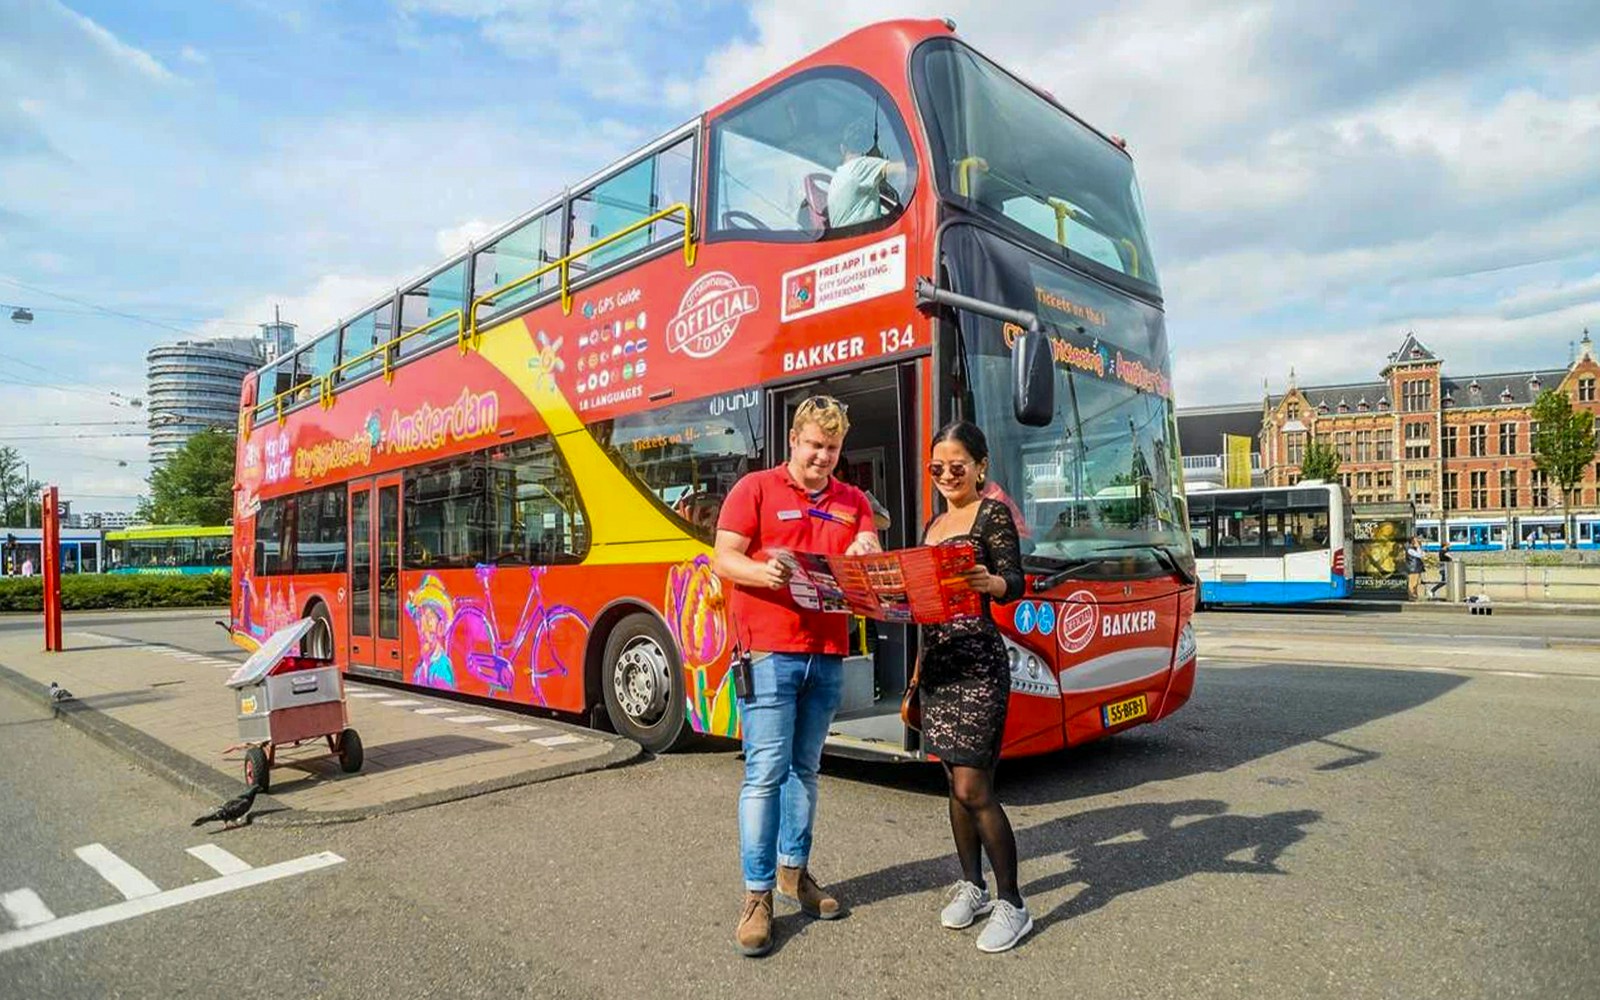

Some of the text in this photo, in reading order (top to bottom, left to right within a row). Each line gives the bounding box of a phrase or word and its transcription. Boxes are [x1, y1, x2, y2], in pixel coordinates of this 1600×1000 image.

[820, 257, 860, 278] FREE APP
[819, 280, 835, 293] CITY
[1035, 286, 1070, 313] Tickets
[598, 287, 641, 314] GPS Guide
[675, 290, 754, 342] OFFICIAL
[695, 323, 731, 352] TOUR
[783, 323, 915, 373] BAKKER 134
[590, 385, 643, 408] LANGUAGES
[387, 385, 498, 455] Amsterdam
[1102, 610, 1156, 637] BAKKER
